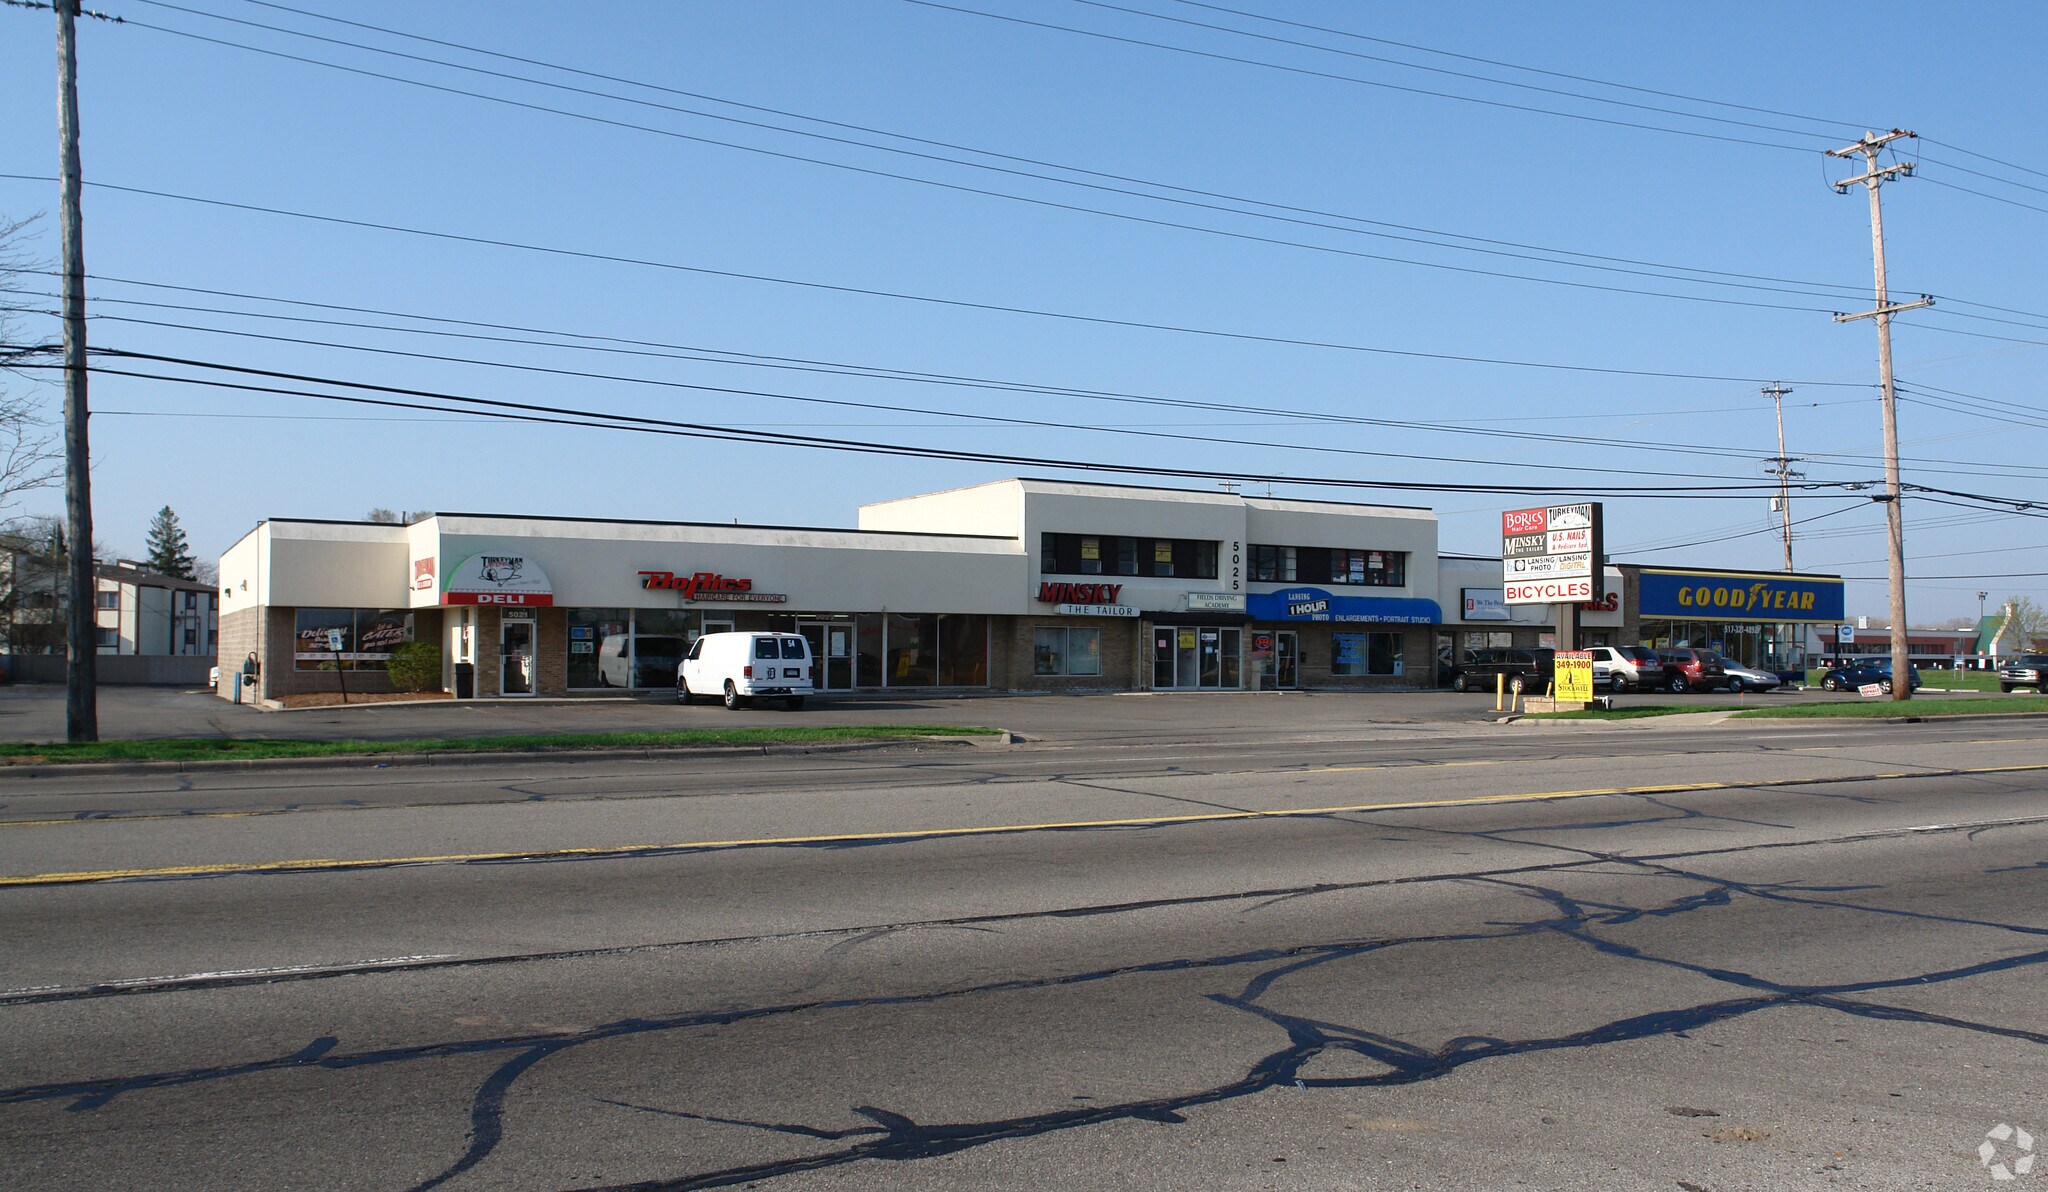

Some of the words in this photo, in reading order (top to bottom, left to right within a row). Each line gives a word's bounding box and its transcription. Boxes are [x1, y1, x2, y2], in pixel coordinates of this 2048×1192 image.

[1549, 505, 1590, 524] TURKEYMAN
[1552, 532, 1564, 541] U.S.
[1567, 530, 1586, 541] NAILS
[1503, 534, 1546, 556] MINSKY
[481, 556, 523, 567] TURKEYMAN
[1527, 556, 1555, 565] LANSING
[1559, 554, 1588, 563] LANSING
[1559, 561, 1586, 570] DIGITAL
[1038, 582, 1123, 604] MINSKY
[1506, 582, 1590, 599] BICYCLES
[477, 594, 524, 604] DELI
[695, 593, 730, 601] HAIRCARE
[733, 593, 746, 601] FOR
[749, 594, 783, 602] EVERYONE
[1288, 593, 1311, 601] LANSING
[1678, 586, 1815, 610] GOODYEAR
[1067, 605, 1090, 614] THE
[1096, 606, 1133, 616] TAILOR
[1290, 606, 1295, 615] 1
[1295, 601, 1327, 614] HOUR
[1335, 614, 1379, 622] ENLARGEMENTS
[1383, 615, 1409, 623] PORTRAIT
[1411, 616, 1431, 624] STUDIO
[1556, 660, 1591, 669] 349-1900
